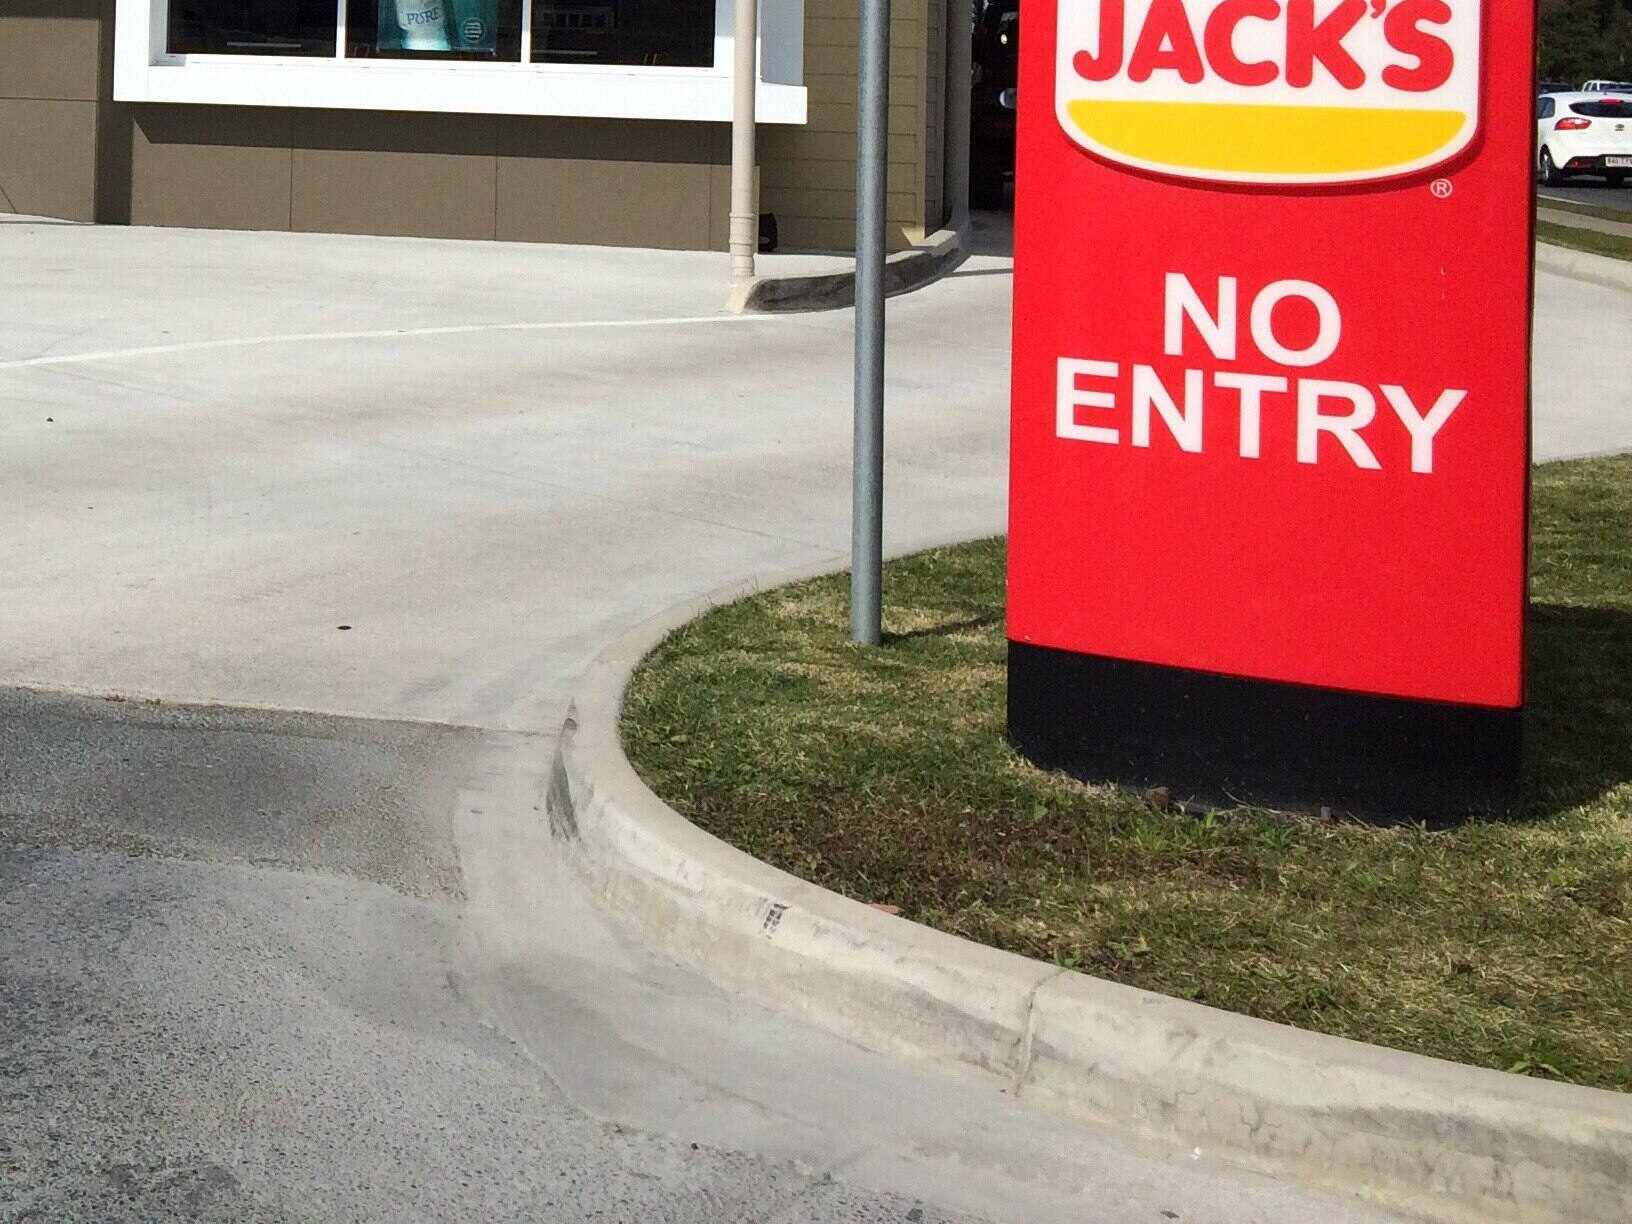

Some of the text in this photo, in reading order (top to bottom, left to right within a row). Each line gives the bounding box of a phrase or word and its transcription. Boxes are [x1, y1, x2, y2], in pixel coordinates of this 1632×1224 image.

[406, 7, 441, 25] PURE
[1163, 272, 1342, 366] NO
[1055, 357, 1468, 474] ENTRY
